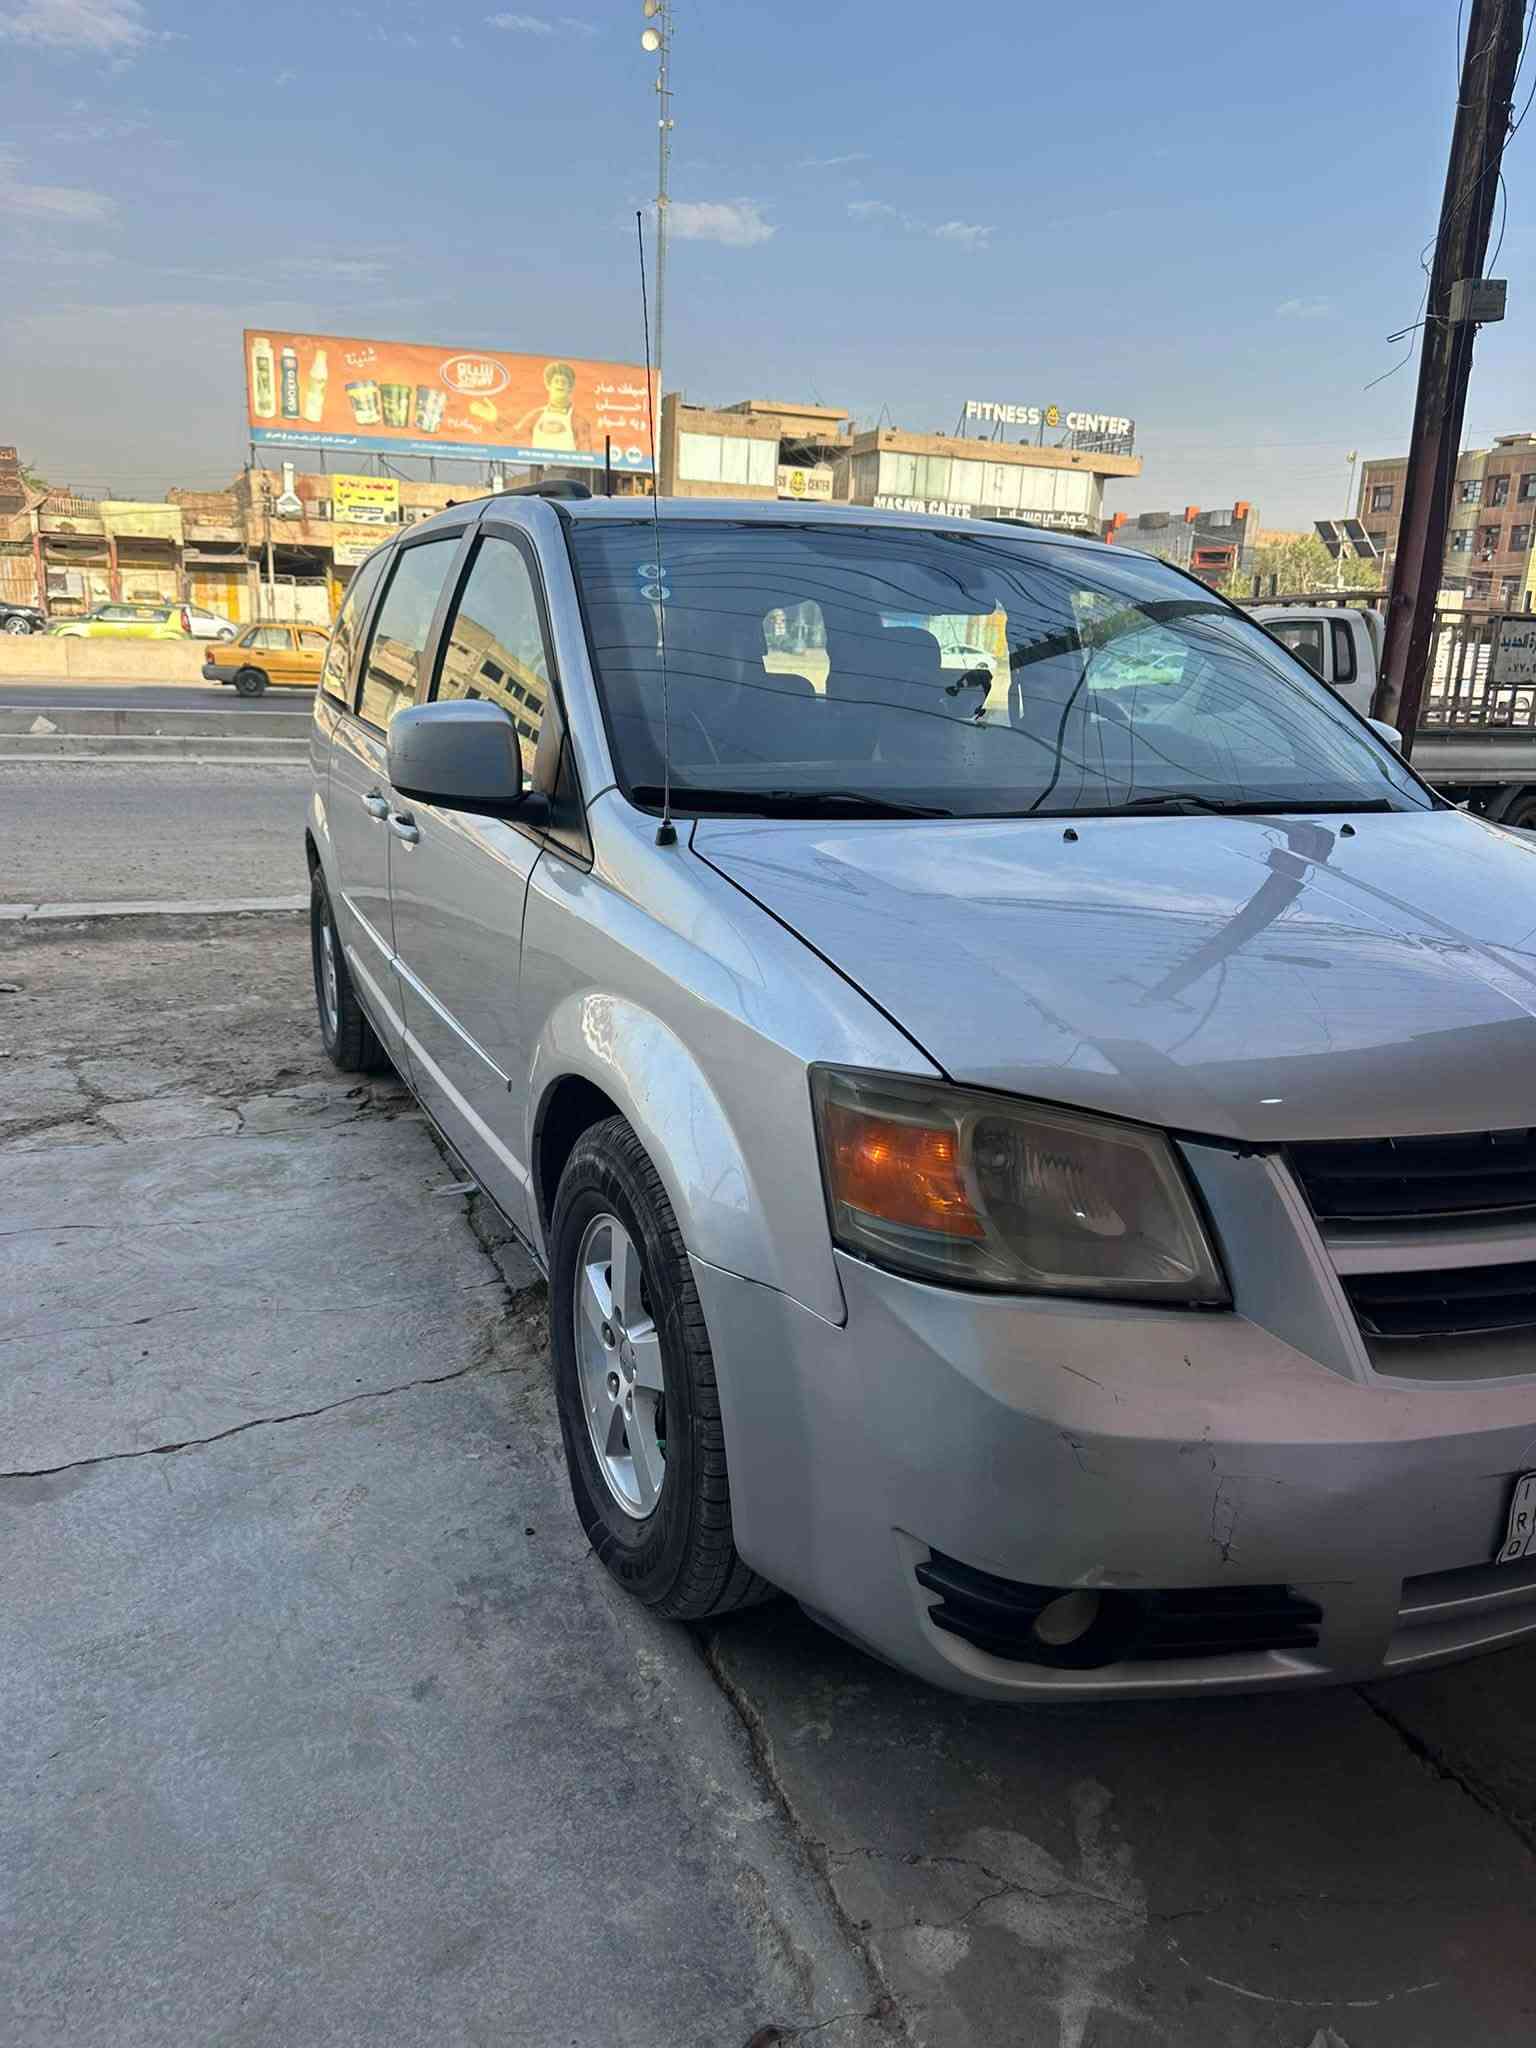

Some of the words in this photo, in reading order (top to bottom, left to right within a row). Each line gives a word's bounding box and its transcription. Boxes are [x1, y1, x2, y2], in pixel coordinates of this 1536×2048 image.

[966, 400, 1040, 425] FITNESS
[1066, 411, 1130, 435] CENTER
[873, 495, 927, 513] MASAYA
[1043, 512, 1089, 529] كوفي
